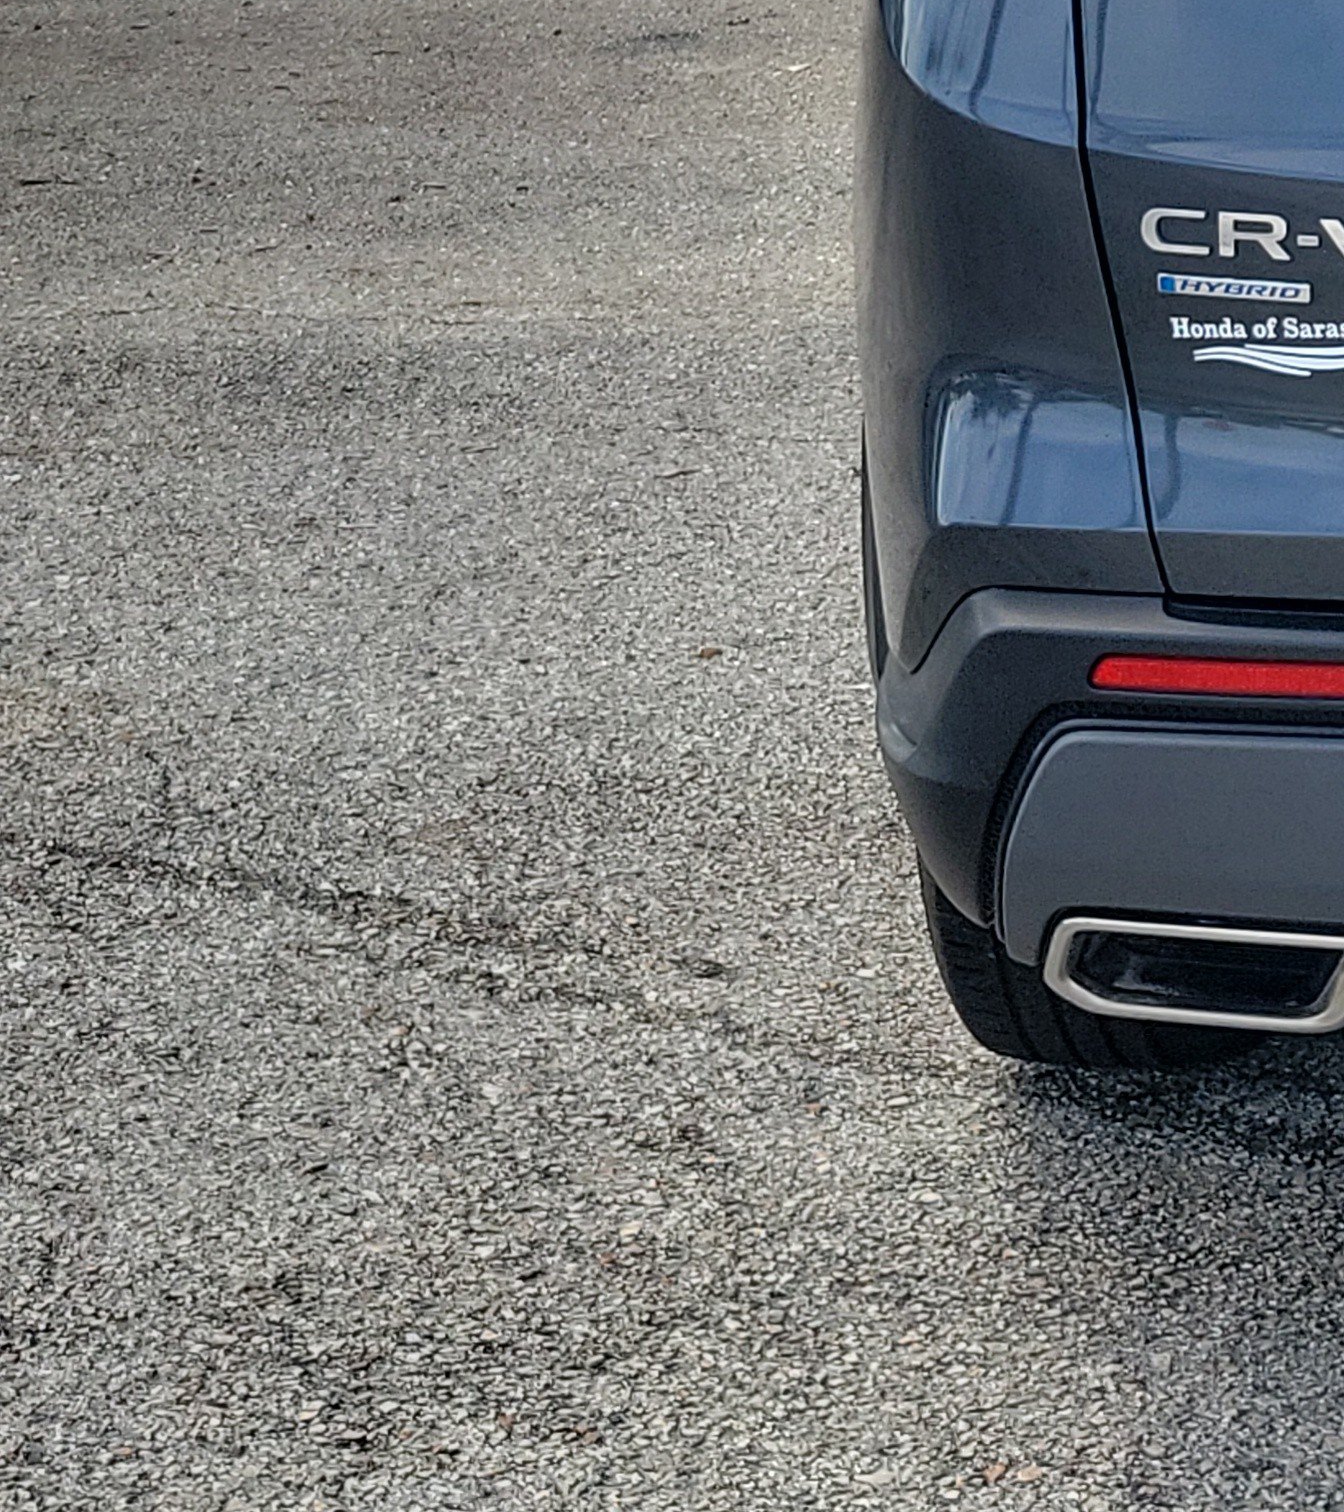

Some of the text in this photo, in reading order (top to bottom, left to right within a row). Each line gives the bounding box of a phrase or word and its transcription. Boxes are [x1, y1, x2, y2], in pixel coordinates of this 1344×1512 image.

[1178, 278, 1302, 300] HYBRID
[1169, 316, 1247, 340] Honda
[1253, 317, 1277, 339] of
